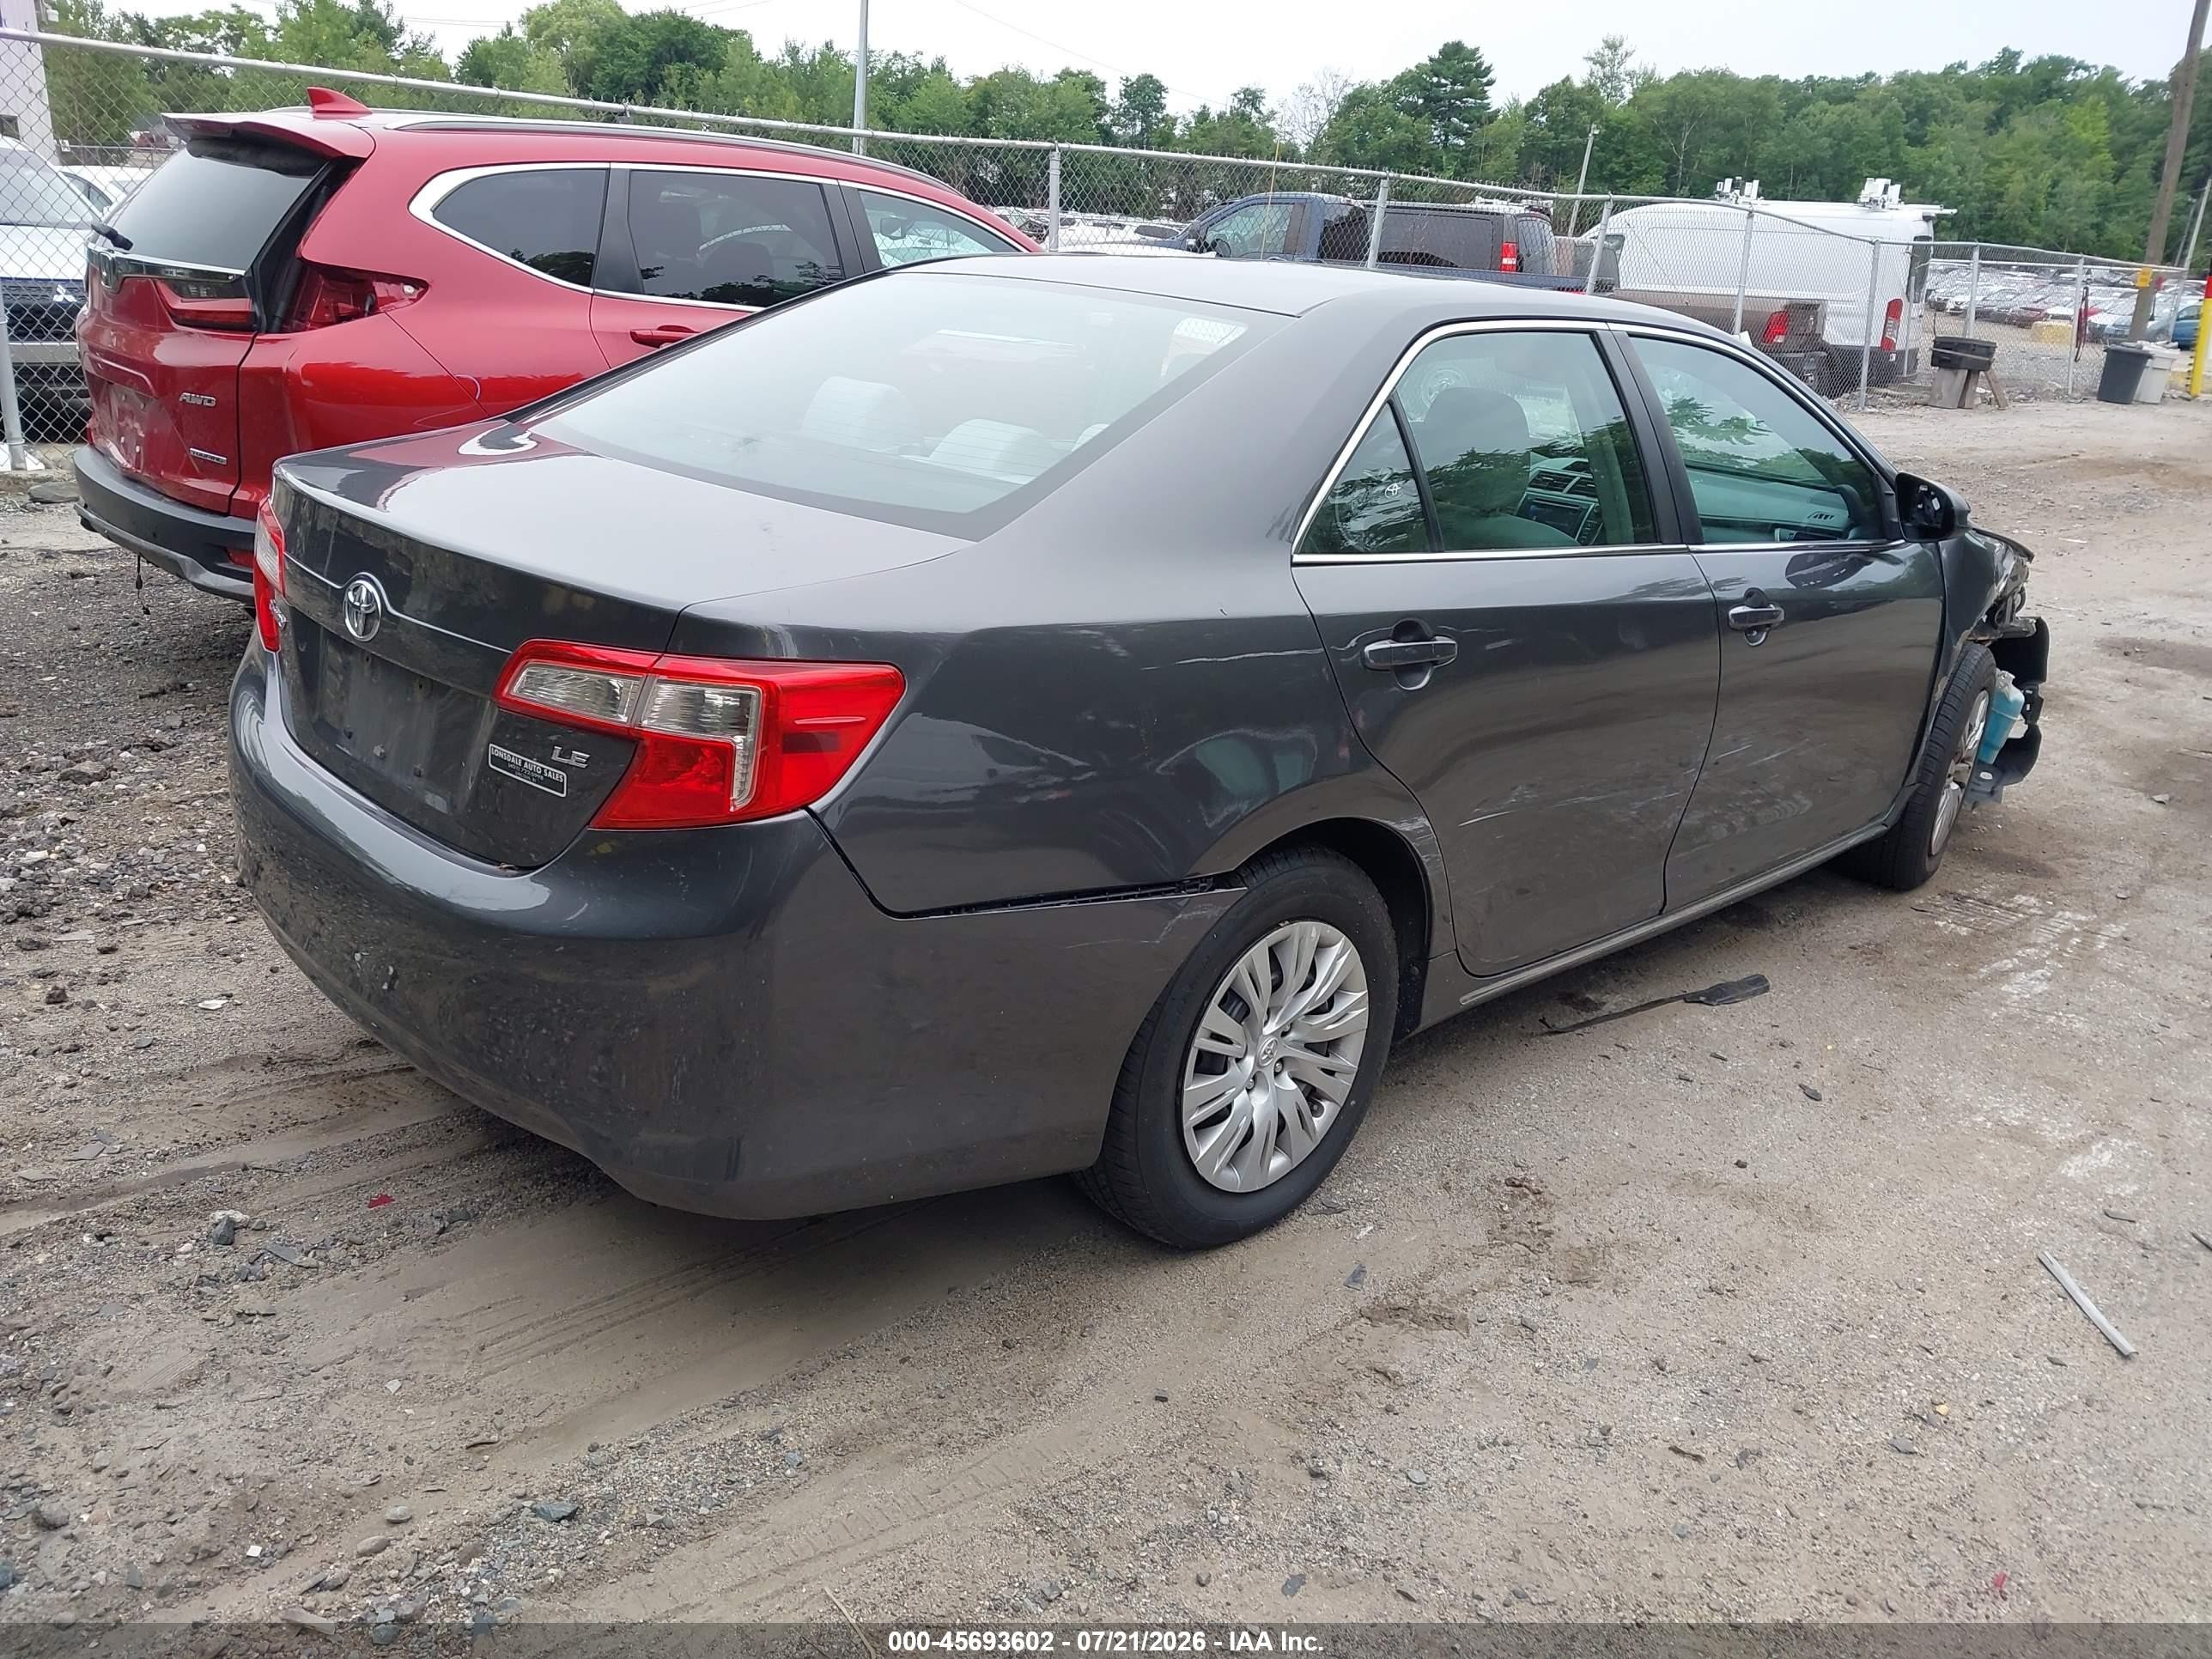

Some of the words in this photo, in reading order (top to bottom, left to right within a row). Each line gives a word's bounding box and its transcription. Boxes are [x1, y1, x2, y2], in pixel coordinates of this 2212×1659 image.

[179, 392, 216, 407] AWD
[491, 747, 522, 767] LONSDALE
[523, 762, 542, 774] AUTO
[543, 769, 563, 782] SALES
[550, 745, 591, 769] LE
